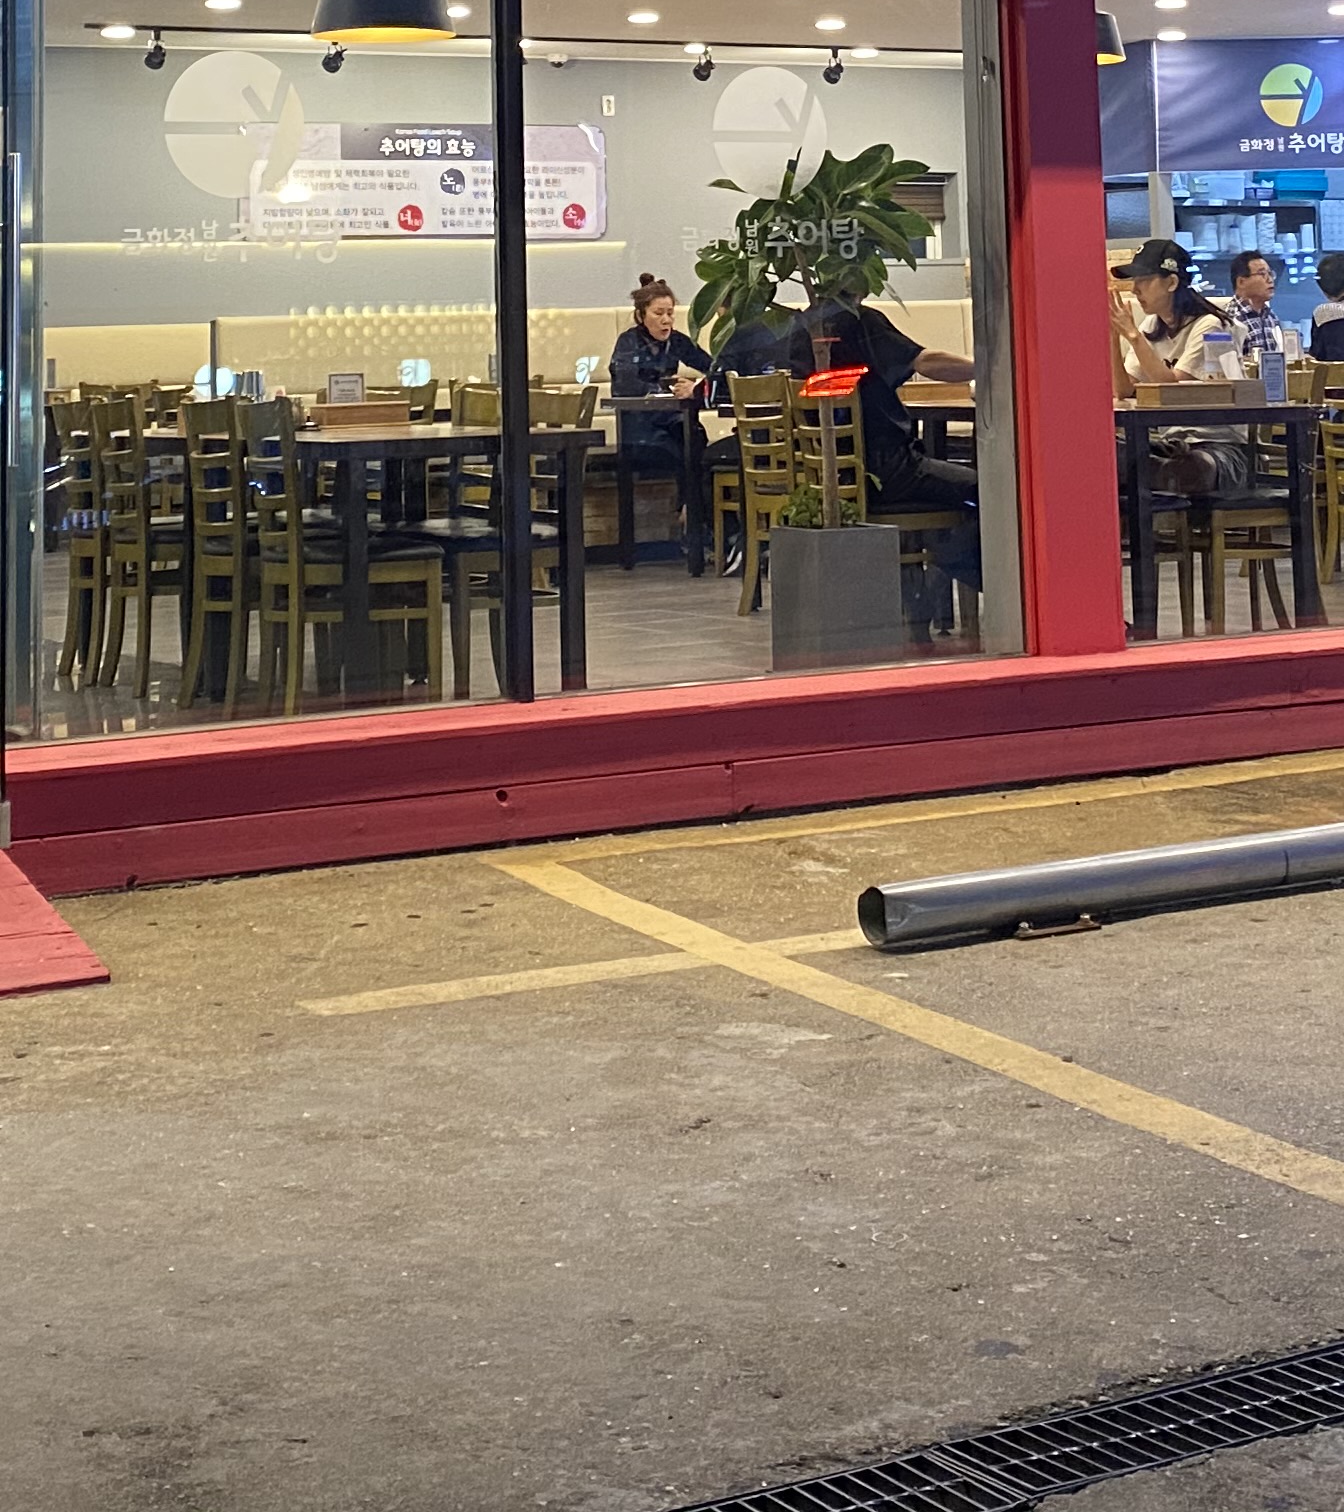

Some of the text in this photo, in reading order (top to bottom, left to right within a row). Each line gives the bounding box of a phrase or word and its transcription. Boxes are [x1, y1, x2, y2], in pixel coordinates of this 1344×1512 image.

[379, 136, 477, 158] 추어탕의 효능
[1238, 138, 1275, 152] 금화정
[764, 215, 865, 260] 추어탕
